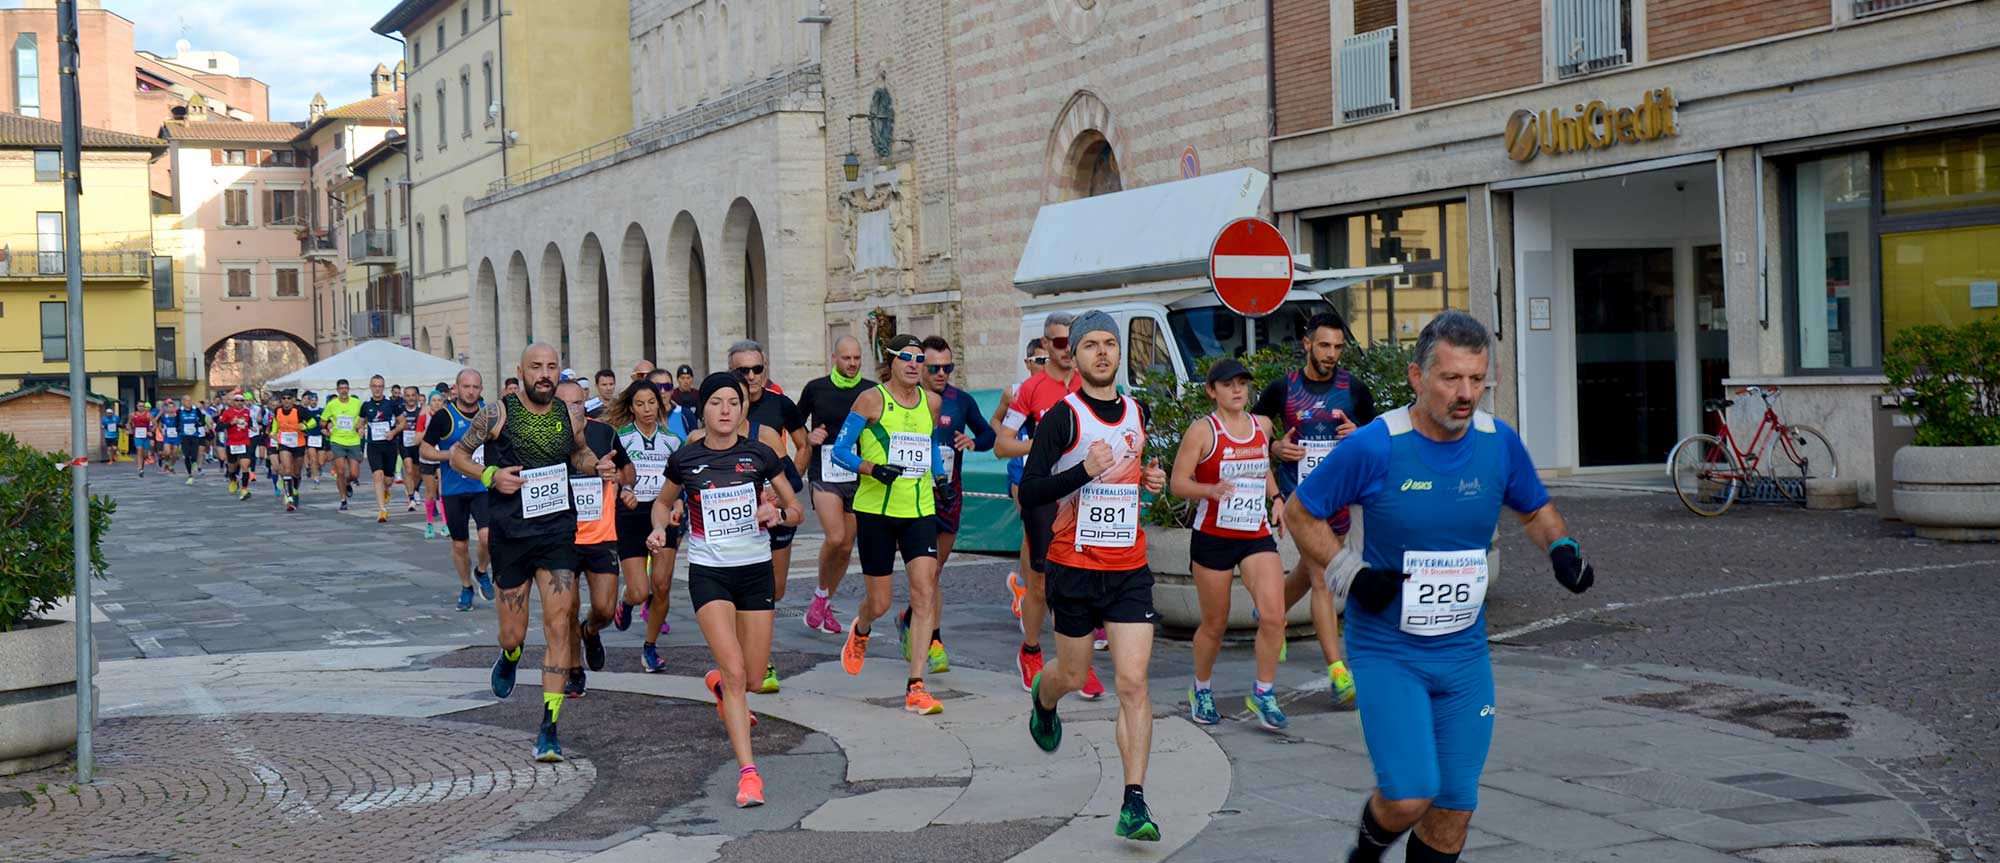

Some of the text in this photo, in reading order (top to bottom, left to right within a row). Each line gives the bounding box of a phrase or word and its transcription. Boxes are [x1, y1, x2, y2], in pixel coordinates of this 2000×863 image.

[1539, 87, 1677, 155] UniCredit
[898, 449, 923, 462] 119
[530, 482, 559, 499] 928
[702, 487, 754, 500] INVERNALISSIMA
[1082, 486, 1137, 496] INVERNALISSIMA
[526, 499, 563, 512] DIPA
[1225, 497, 1262, 511] 1245
[707, 504, 752, 523] 1099
[1089, 507, 1126, 523] 881
[709, 523, 753, 537] DIPA
[1080, 529, 1131, 539] DIPA
[1406, 557, 1486, 567] INVERNALISSIMA
[1431, 567, 1460, 575] Dicembre
[1419, 584, 1470, 604] 226
[1407, 612, 1472, 625] DIPA
